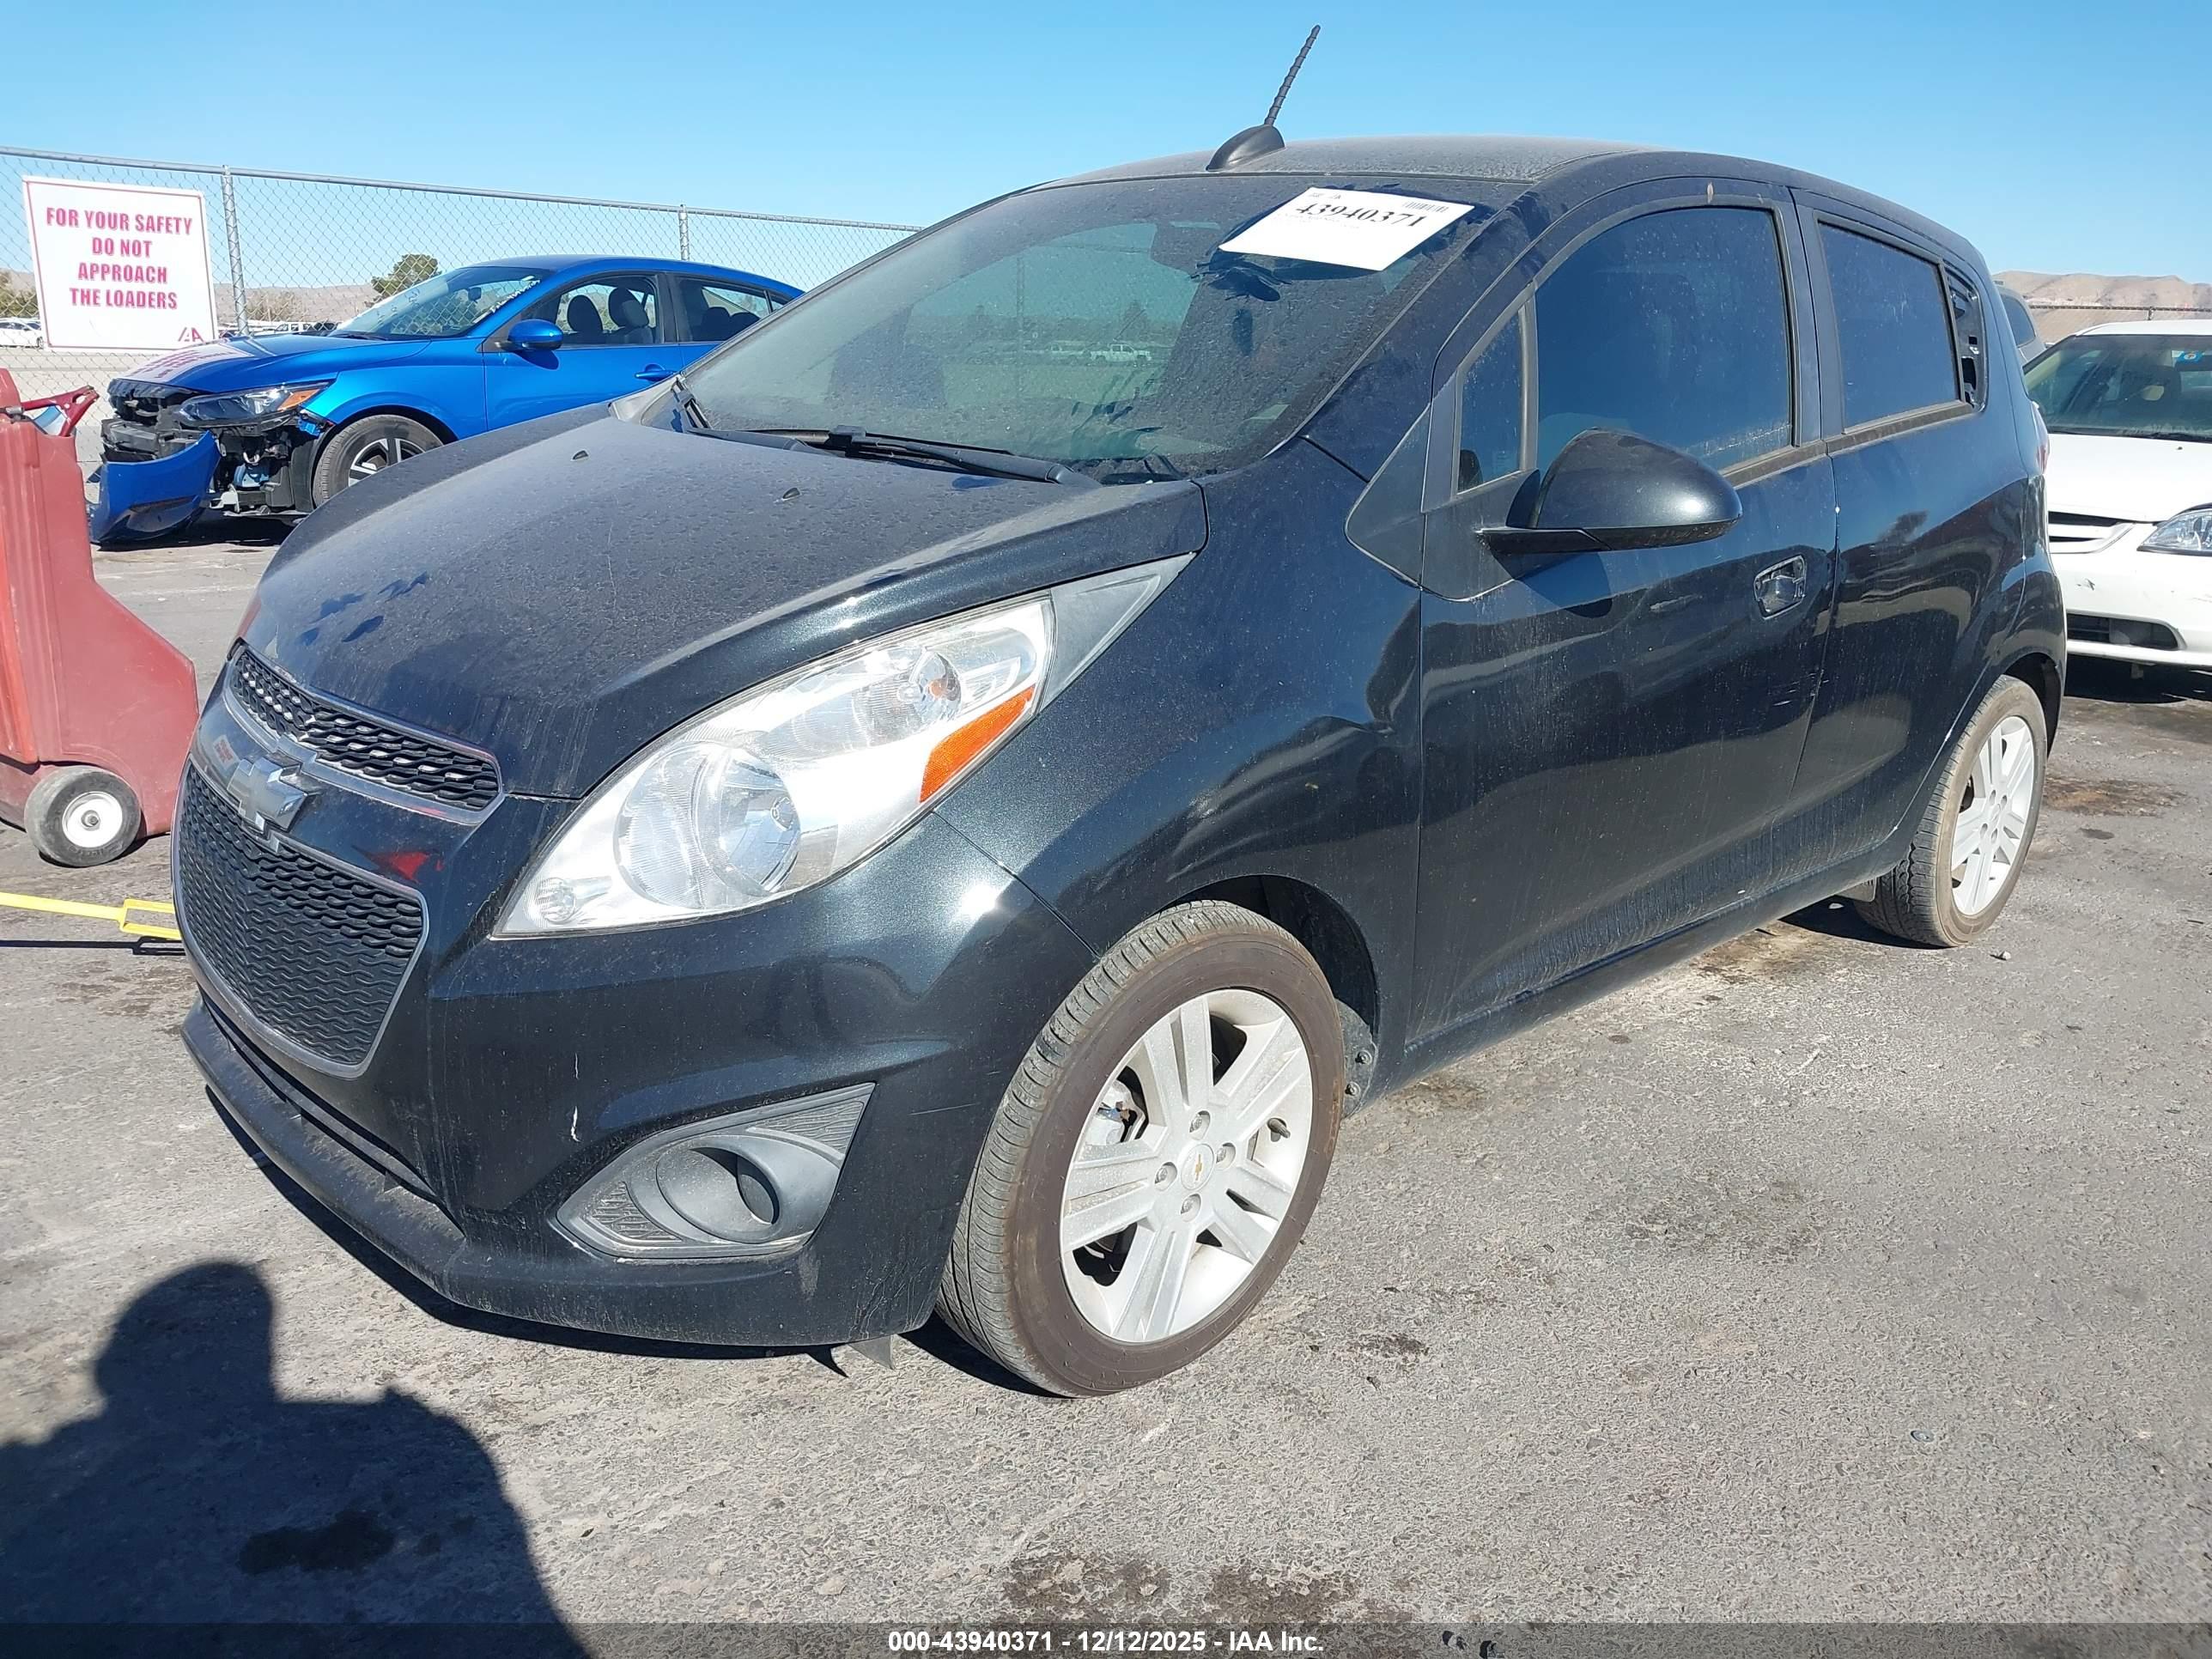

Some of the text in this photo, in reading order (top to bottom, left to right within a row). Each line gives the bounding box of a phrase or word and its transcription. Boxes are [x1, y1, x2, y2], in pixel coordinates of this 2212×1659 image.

[46, 207, 192, 234] FOR YOUR SAFETY
[1295, 203, 1427, 227] 43940371
[92, 237, 152, 258] DO NOT
[78, 262, 167, 284] APPROACH
[70, 287, 178, 310] THE LOADERS
